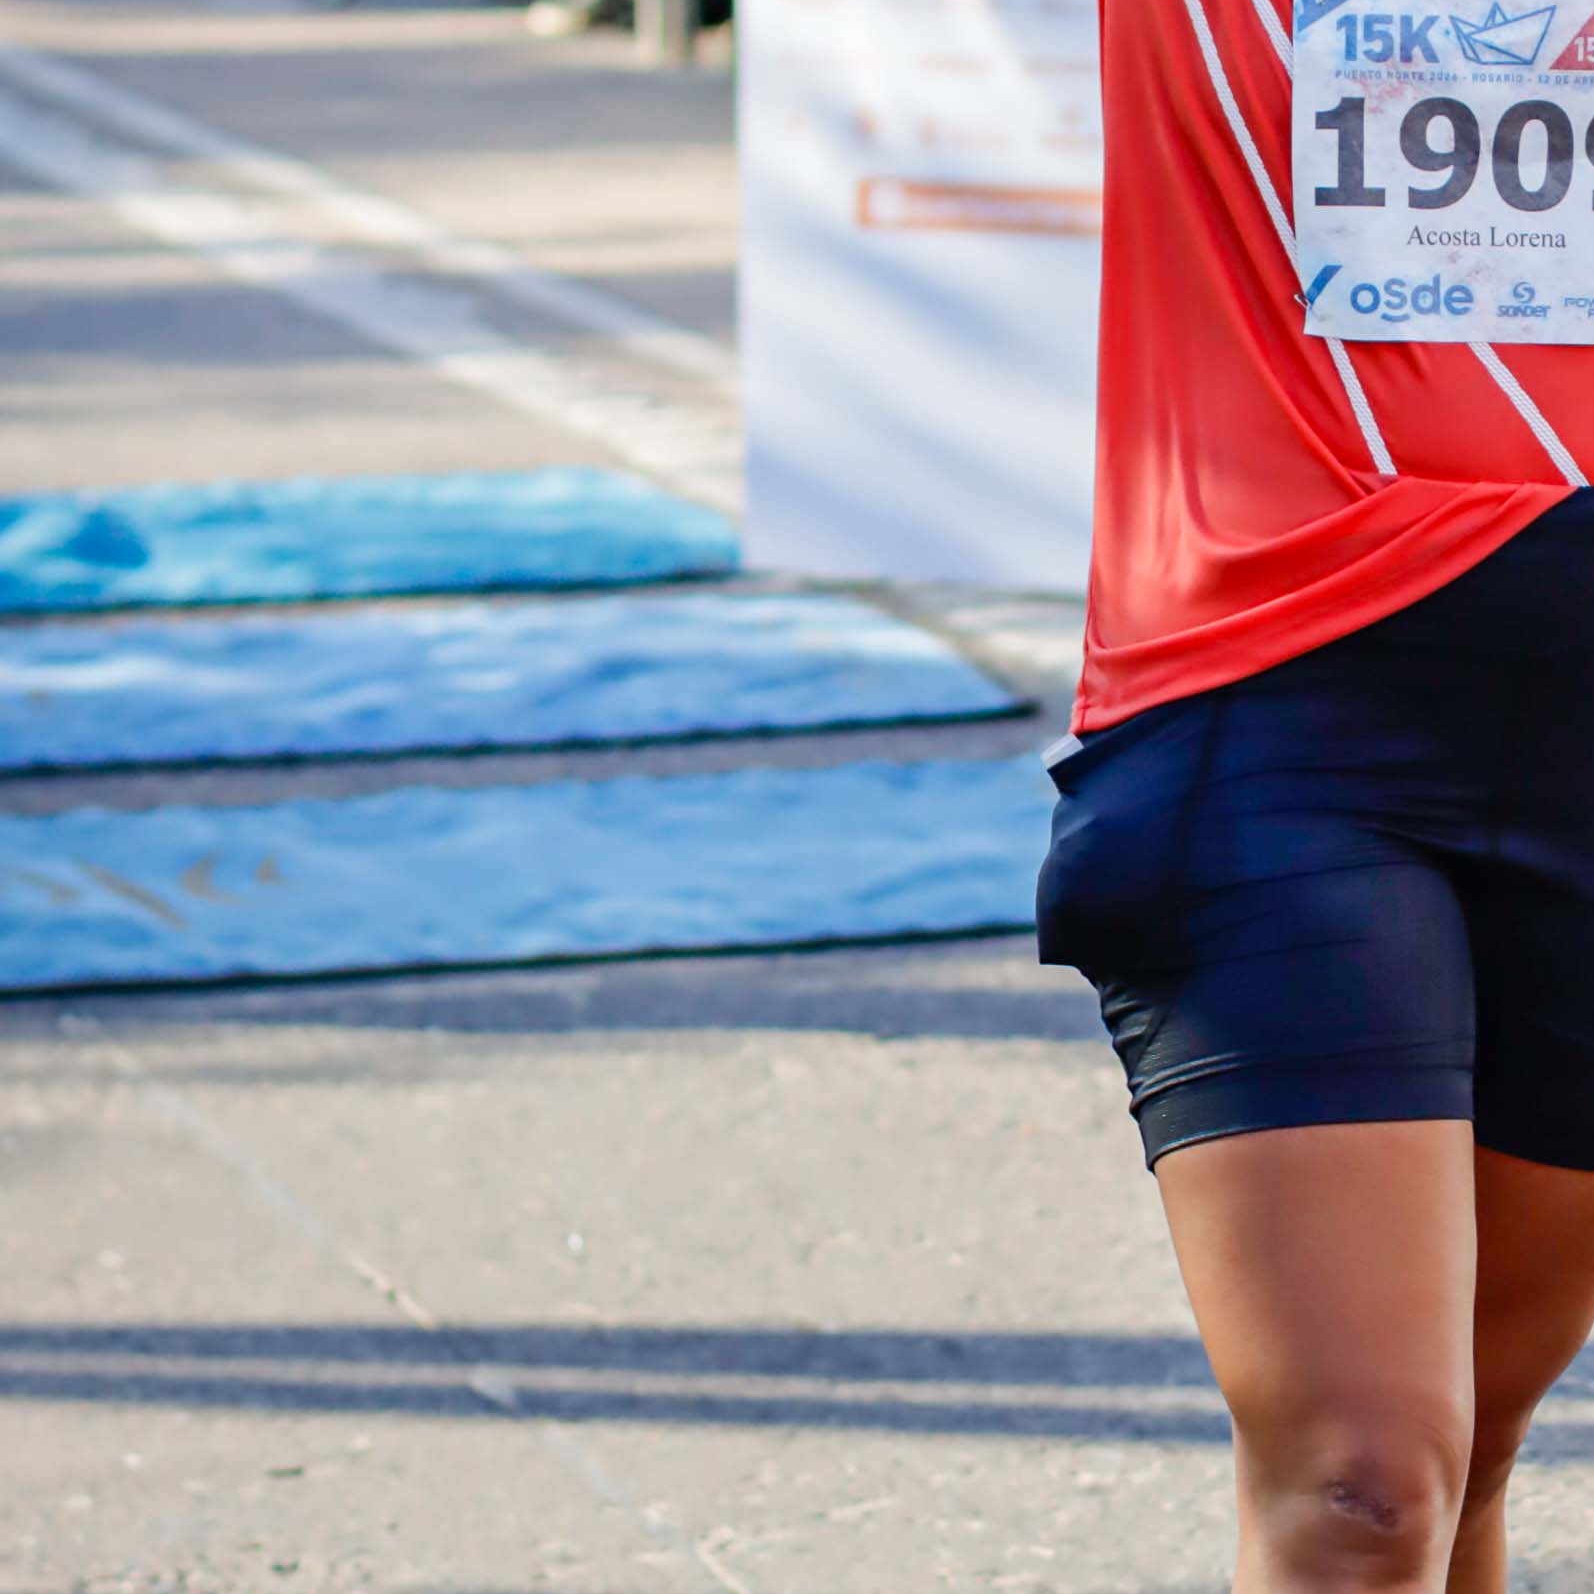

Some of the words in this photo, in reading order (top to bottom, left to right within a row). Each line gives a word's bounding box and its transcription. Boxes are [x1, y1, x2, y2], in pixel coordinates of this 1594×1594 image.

[1336, 13, 1440, 63] 15K
[1335, 70, 1382, 79] PUERTO
[1387, 70, 1425, 81] NORTE
[1406, 225, 1481, 248] Acosta
[1490, 226, 1567, 249] Lorena
[1350, 273, 1474, 323] osde
